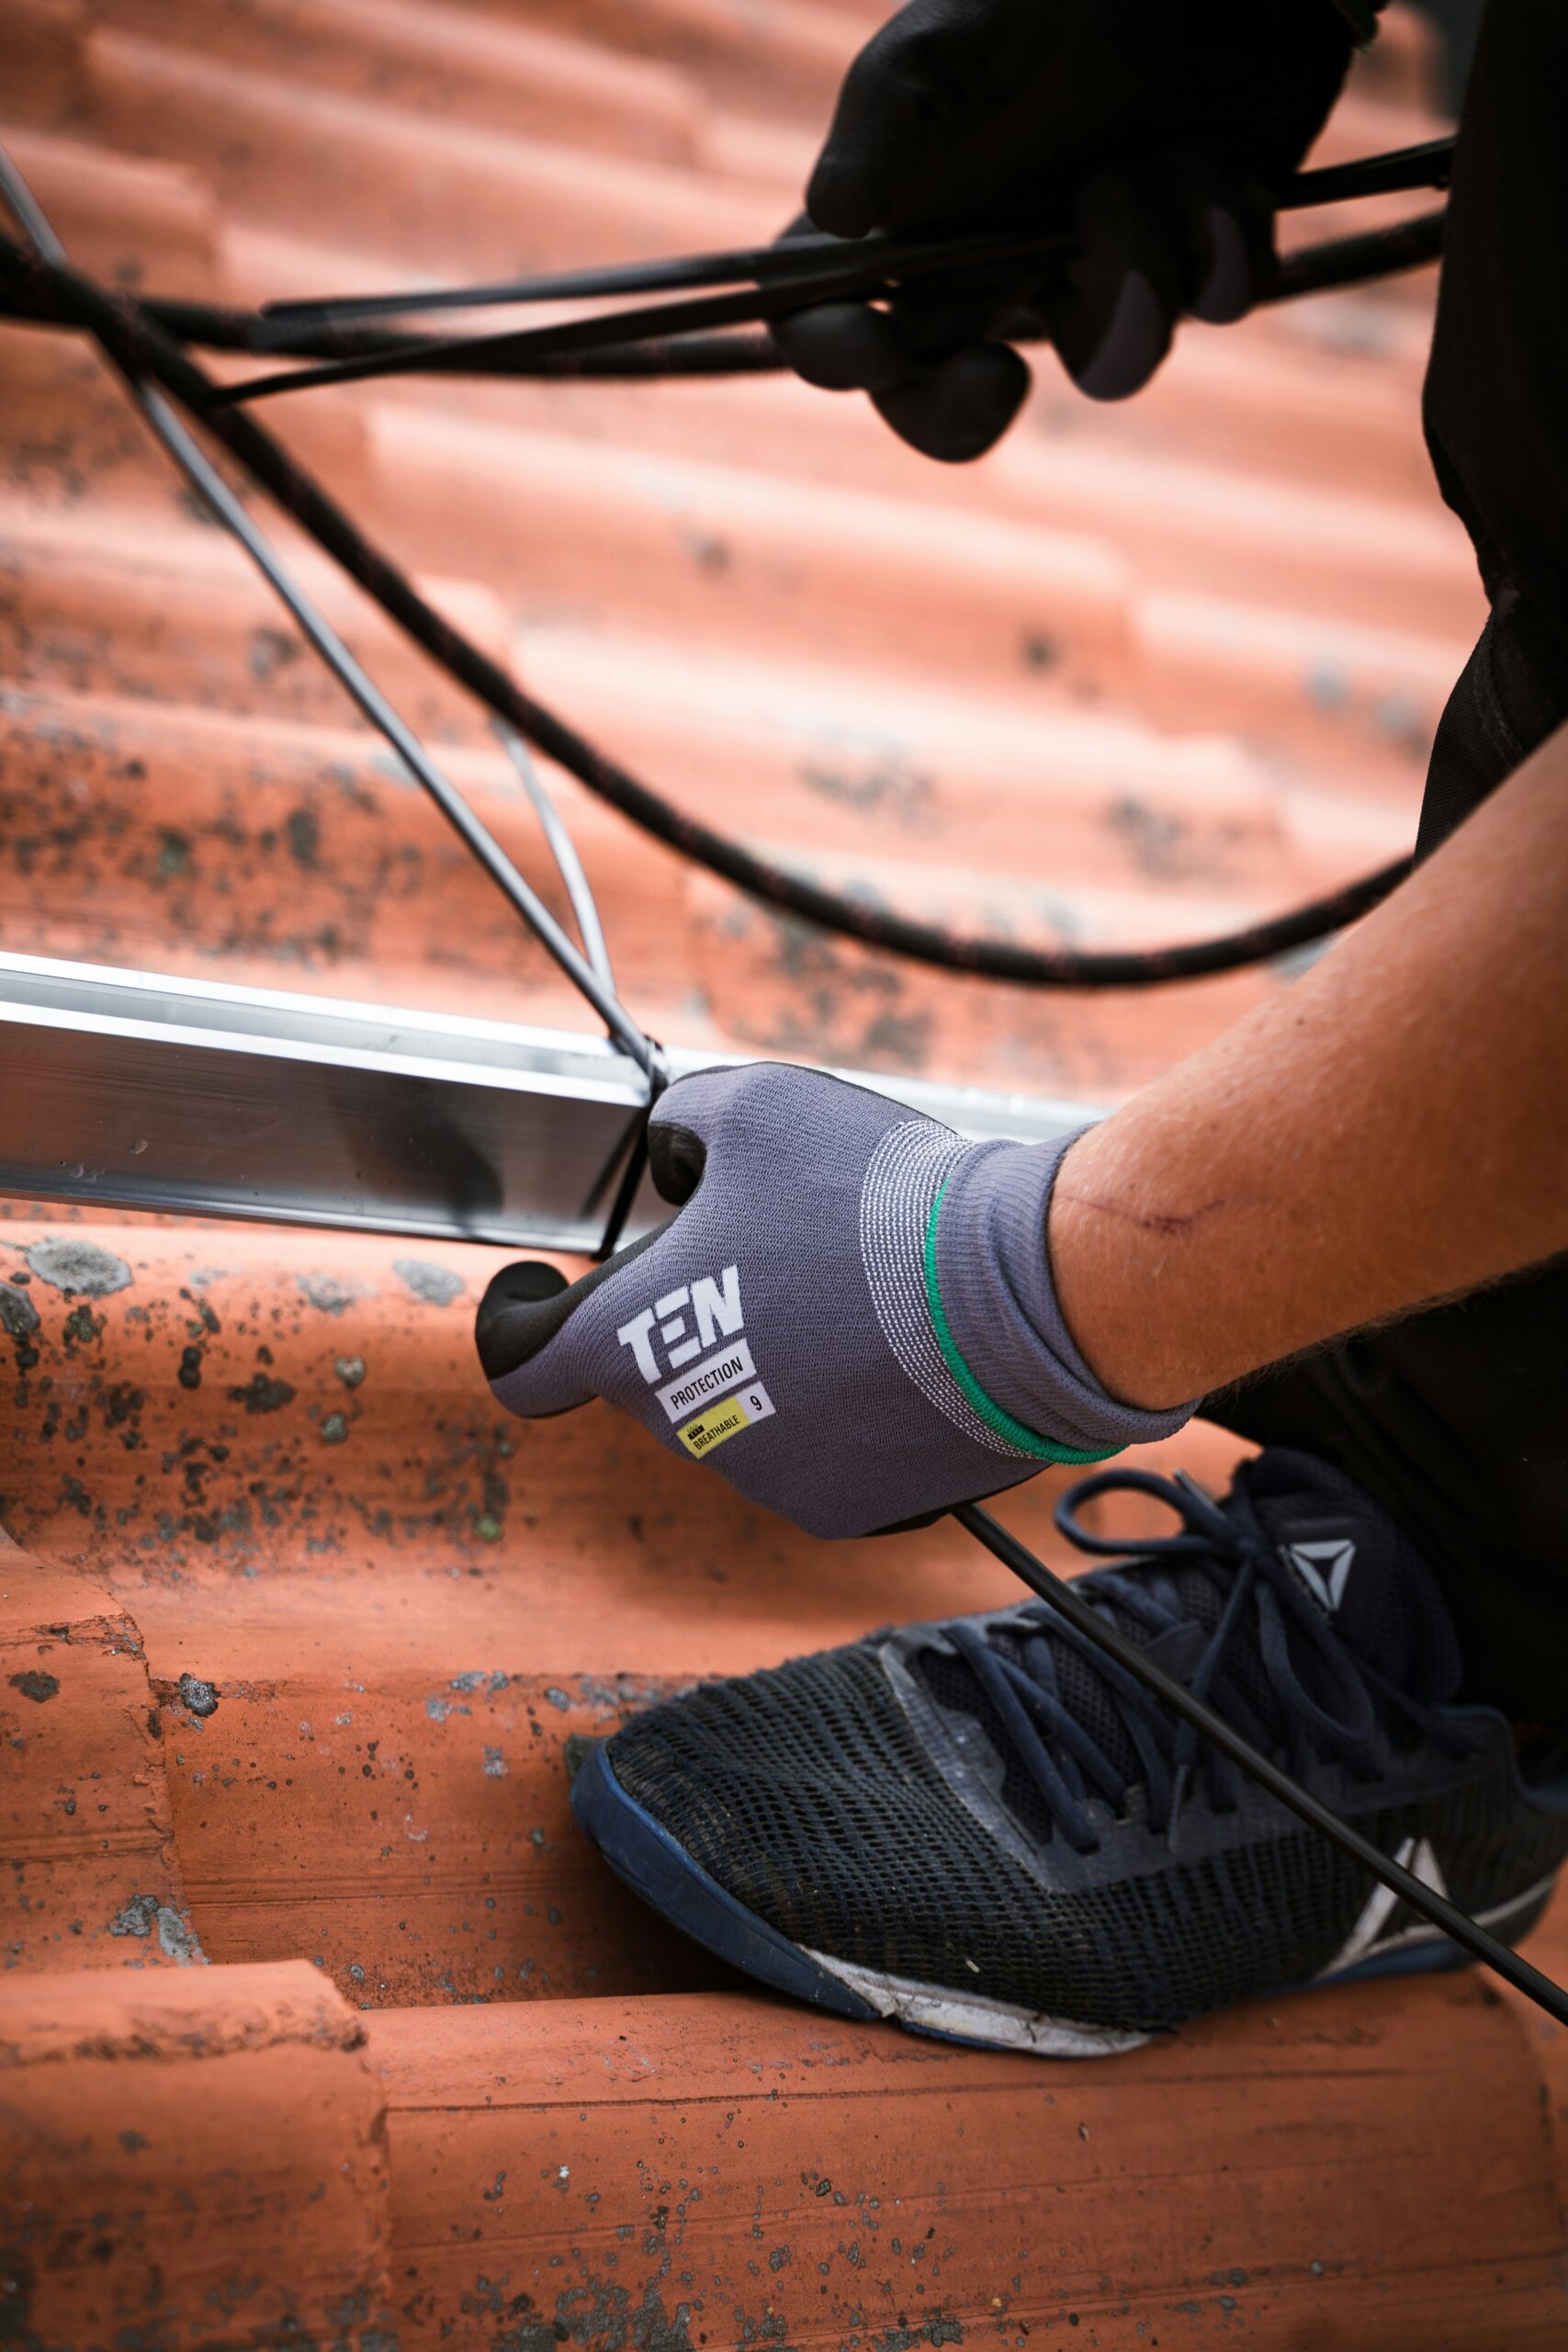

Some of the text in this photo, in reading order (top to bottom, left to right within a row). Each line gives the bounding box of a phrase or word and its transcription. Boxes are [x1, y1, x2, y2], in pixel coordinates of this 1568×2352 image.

[617, 1264, 744, 1385] TEN
[670, 1356, 744, 1410] PROTECTION
[750, 1395, 762, 1411] 9
[693, 1414, 740, 1450] BREATHABLE
